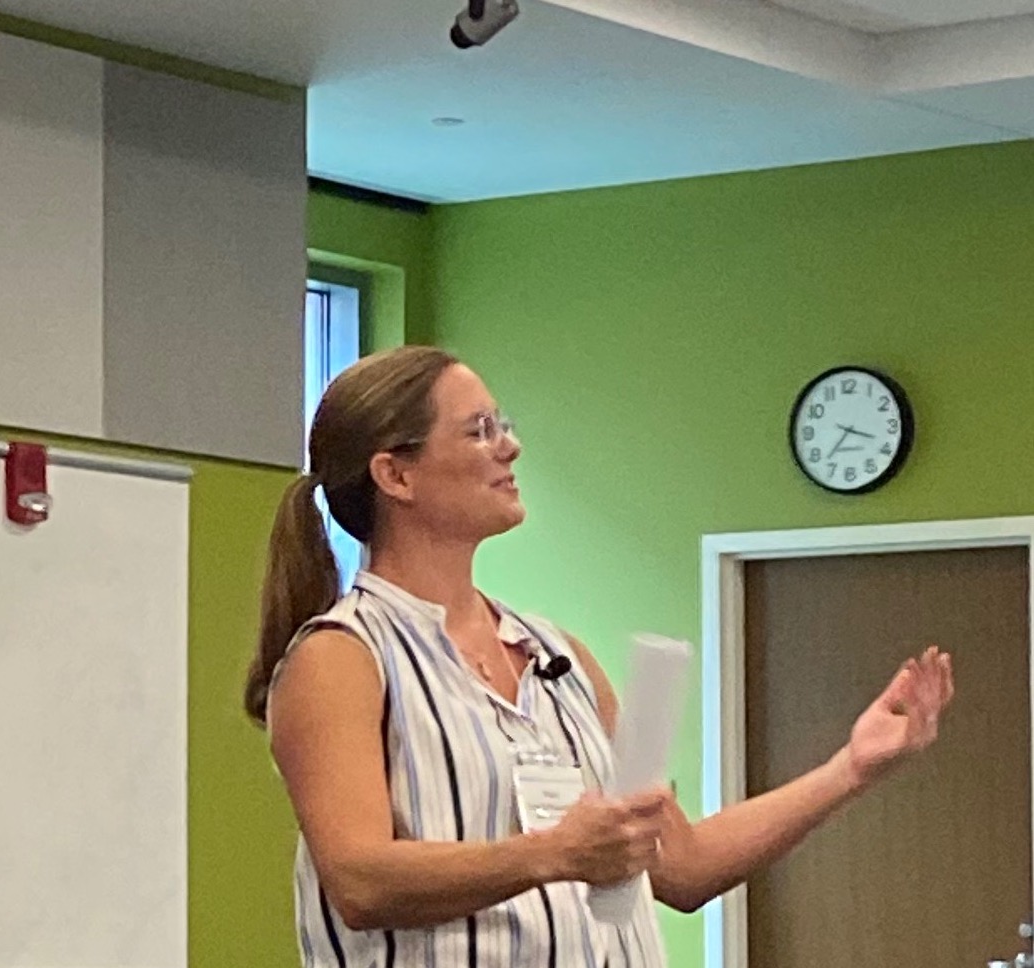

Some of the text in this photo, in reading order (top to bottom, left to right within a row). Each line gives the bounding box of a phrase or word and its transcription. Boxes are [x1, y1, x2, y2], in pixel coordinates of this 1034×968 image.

[825, 386, 835, 401] 11
[841, 378, 857, 394] 12
[808, 403, 825, 419] 10
[878, 396, 890, 412] 2
[802, 425, 815, 441] 9
[887, 418, 898, 434] 3
[810, 447, 821, 463] 8
[880, 442, 892, 456] 4
[827, 462, 838, 478] 7
[865, 458, 878, 474] 5
[844, 467, 857, 482] 6
